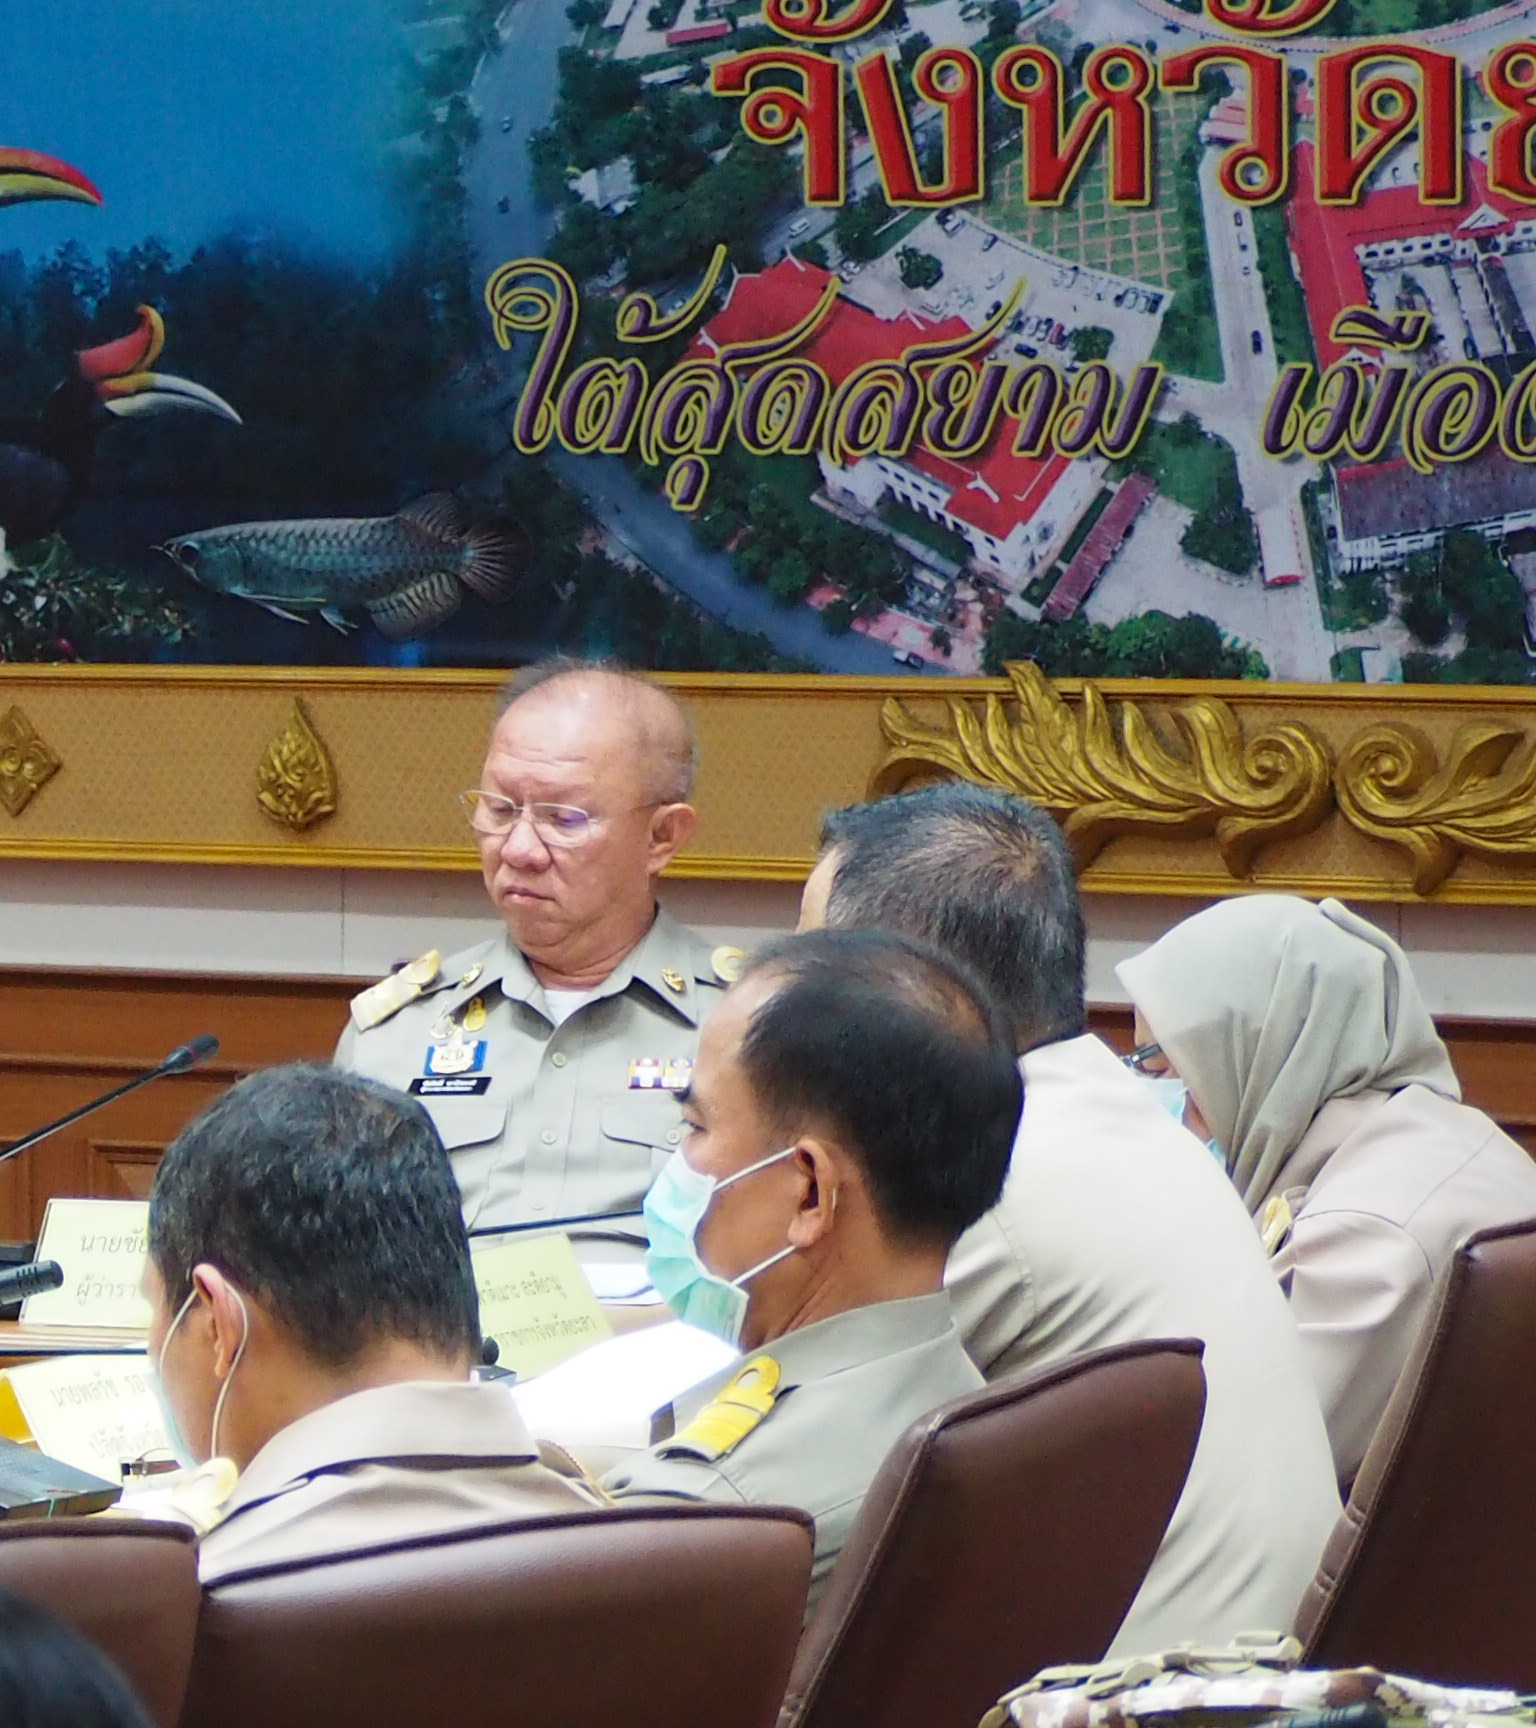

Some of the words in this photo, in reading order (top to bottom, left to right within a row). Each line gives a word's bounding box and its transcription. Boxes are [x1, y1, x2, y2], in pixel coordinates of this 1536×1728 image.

[484, 246, 1166, 511] ใต้สุดสยาม
[75, 1272, 138, 1306] ผู้ว่ารา
